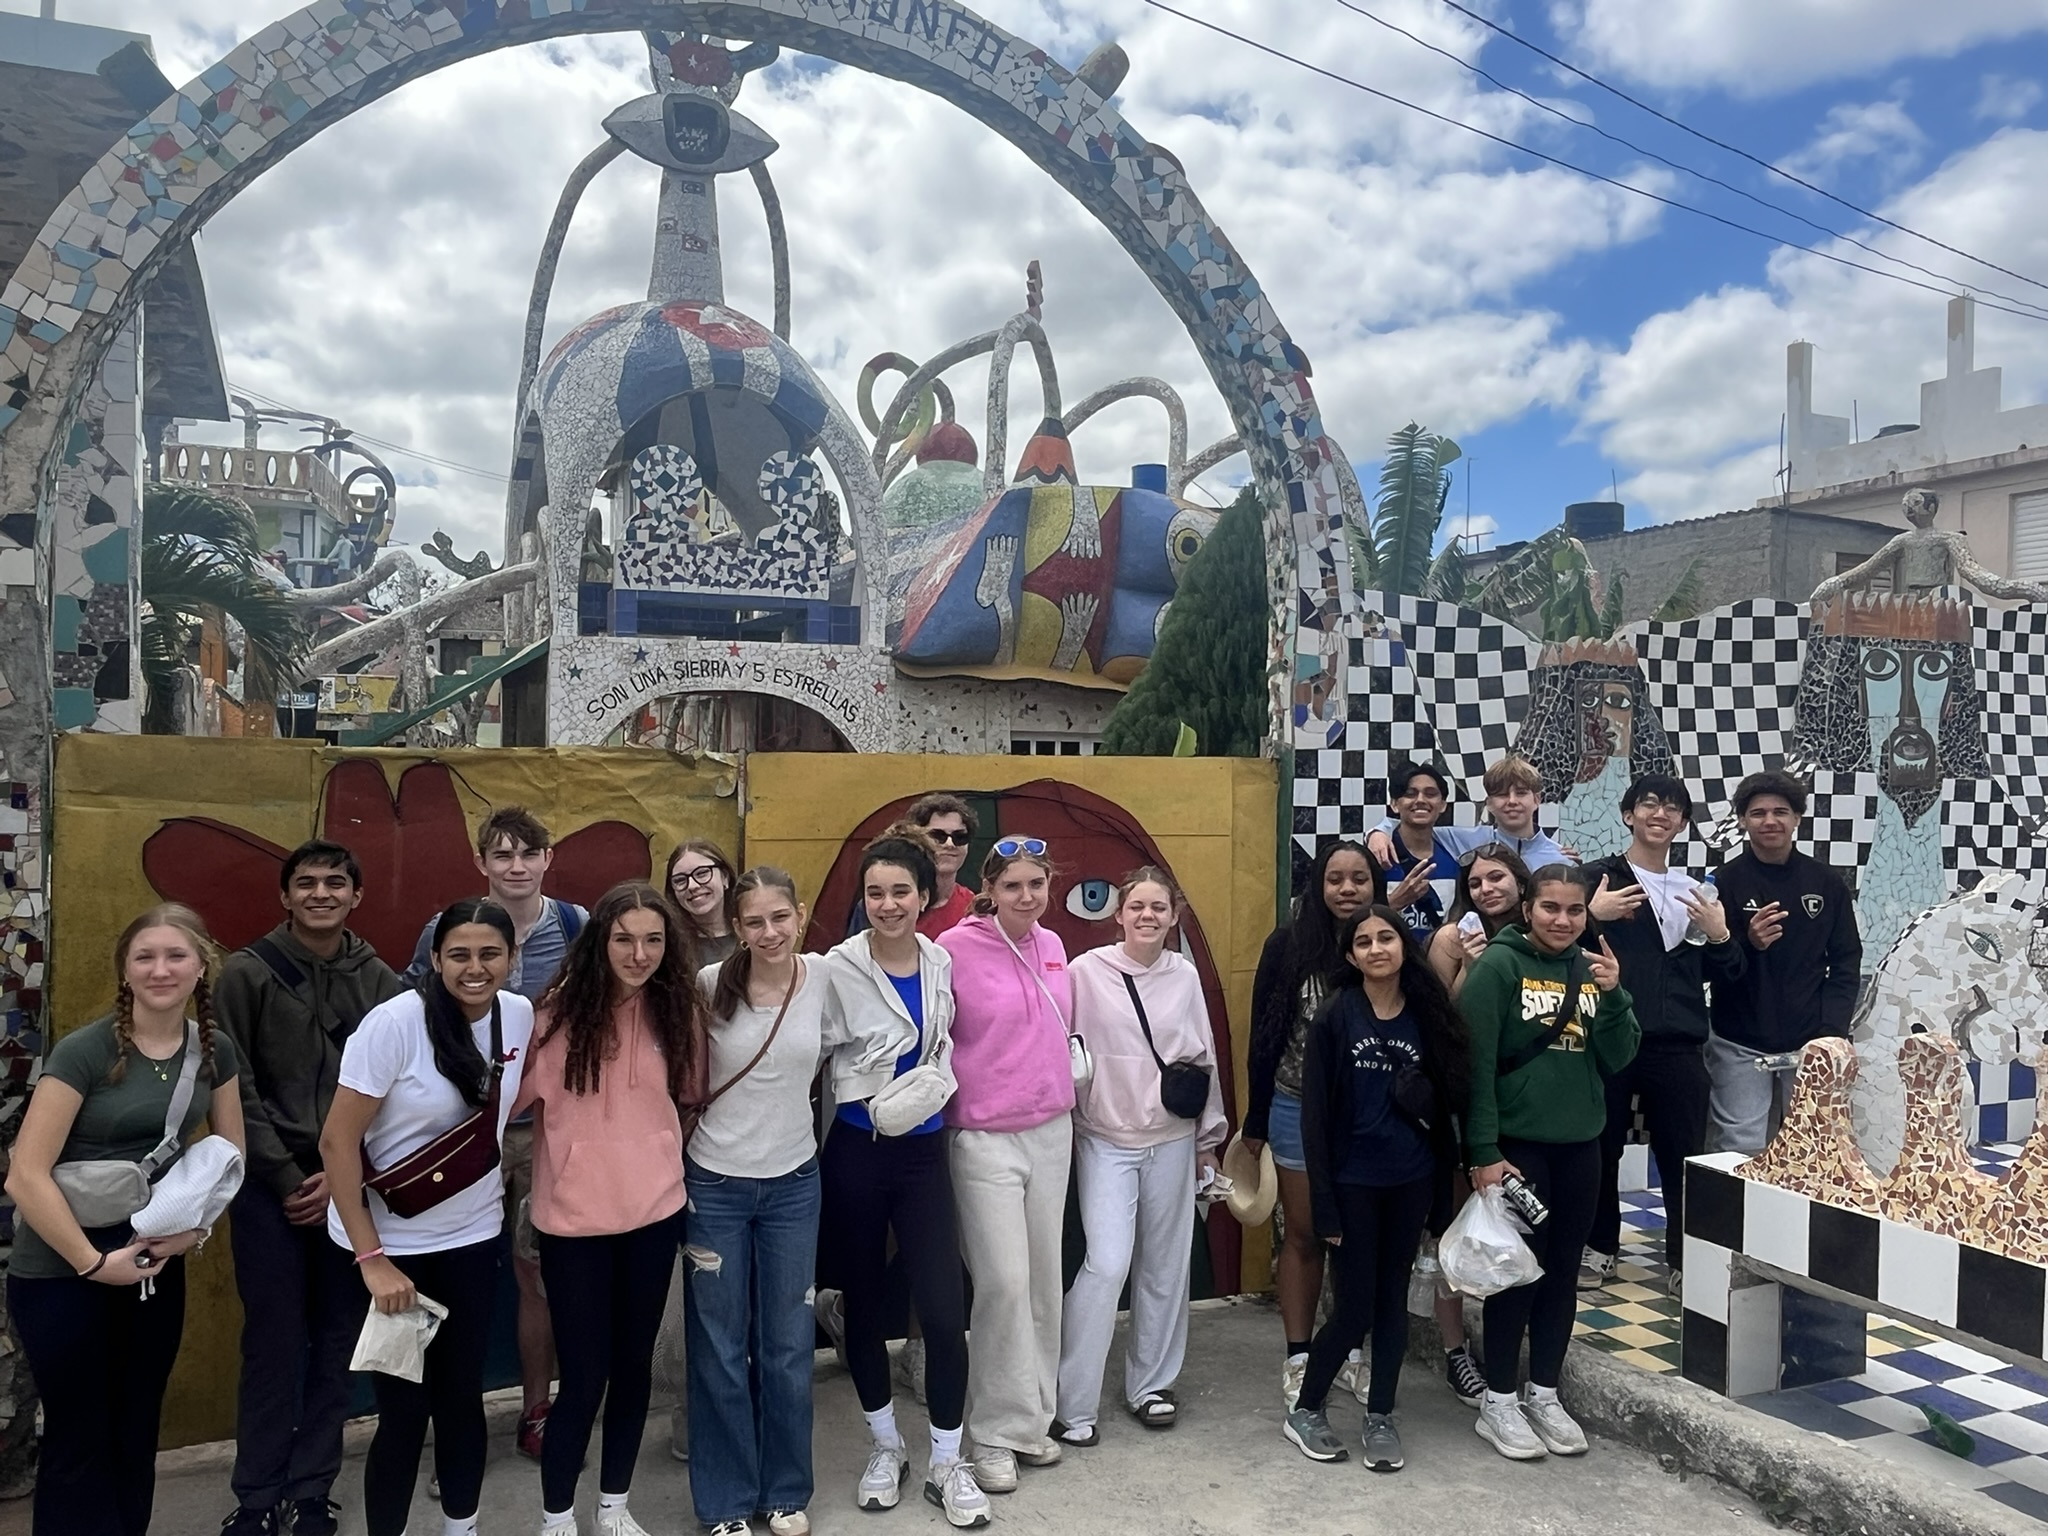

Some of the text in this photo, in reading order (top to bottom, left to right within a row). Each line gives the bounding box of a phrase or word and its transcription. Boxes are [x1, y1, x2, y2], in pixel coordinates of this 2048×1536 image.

[586, 659, 859, 722] SON UNA SIERRA Y 5 ESTRELLAS
[1351, 1037, 1420, 1062] ABERCOMBIE
[1355, 1060, 1378, 1070] AND
